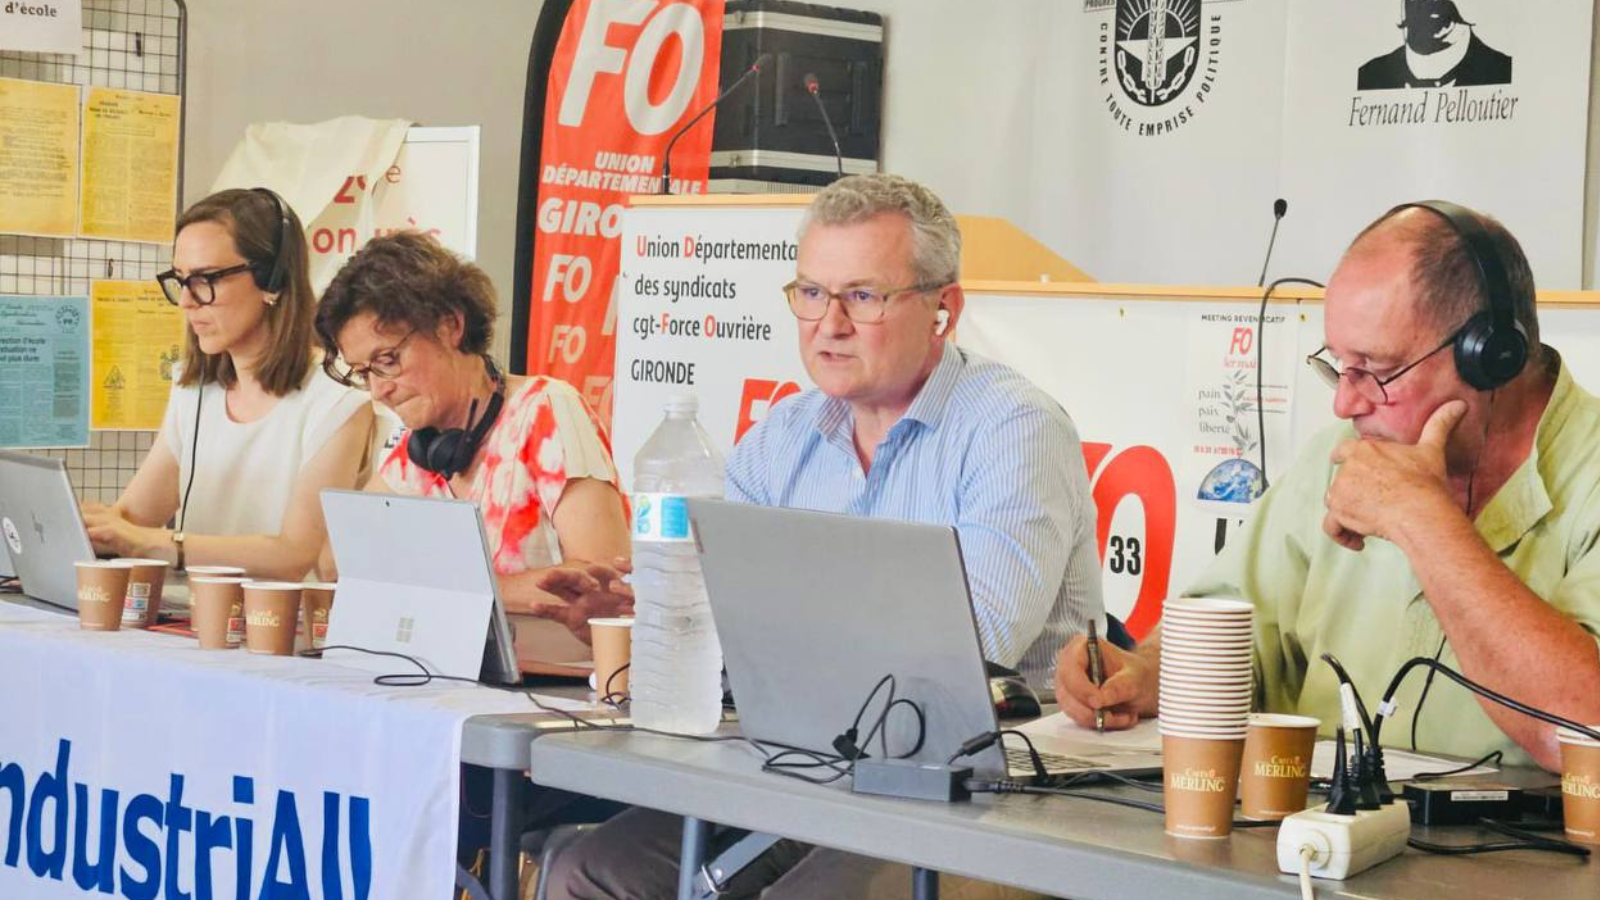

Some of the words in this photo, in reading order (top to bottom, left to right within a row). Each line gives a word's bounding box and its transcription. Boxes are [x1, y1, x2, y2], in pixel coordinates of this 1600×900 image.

[4, 1, 58, 18] d'école
[558, 0, 705, 136] FO
[1099, 22, 1108, 85] CONTRE
[1105, 93, 1132, 130] TOUTE
[1138, 106, 1194, 136] EMPRISE
[1196, 15, 1221, 103] POLITIQUE
[1349, 91, 1429, 126] Fernand
[1435, 89, 1518, 123] Pelloutier
[595, 150, 655, 173] UNION
[542, 162, 701, 195] DÉPARTEMENALE
[538, 198, 623, 238] GIRO
[636, 235, 679, 258] Union
[684, 235, 798, 264] Départementa
[543, 254, 592, 303] FO
[635, 273, 659, 296] des
[663, 275, 736, 302] syndicats
[633, 313, 700, 340] cgt-Force
[704, 314, 771, 341] Ouvrière
[1230, 327, 1252, 355] FO
[548, 325, 587, 364] FO
[631, 358, 696, 385] GIRONDE
[735, 377, 801, 446] F
[1109, 535, 1142, 577] 33
[1170, 772, 1226, 792] MERLING
[1255, 762, 1305, 778] MERLING
[0, 738, 372, 900] ndustriAll
